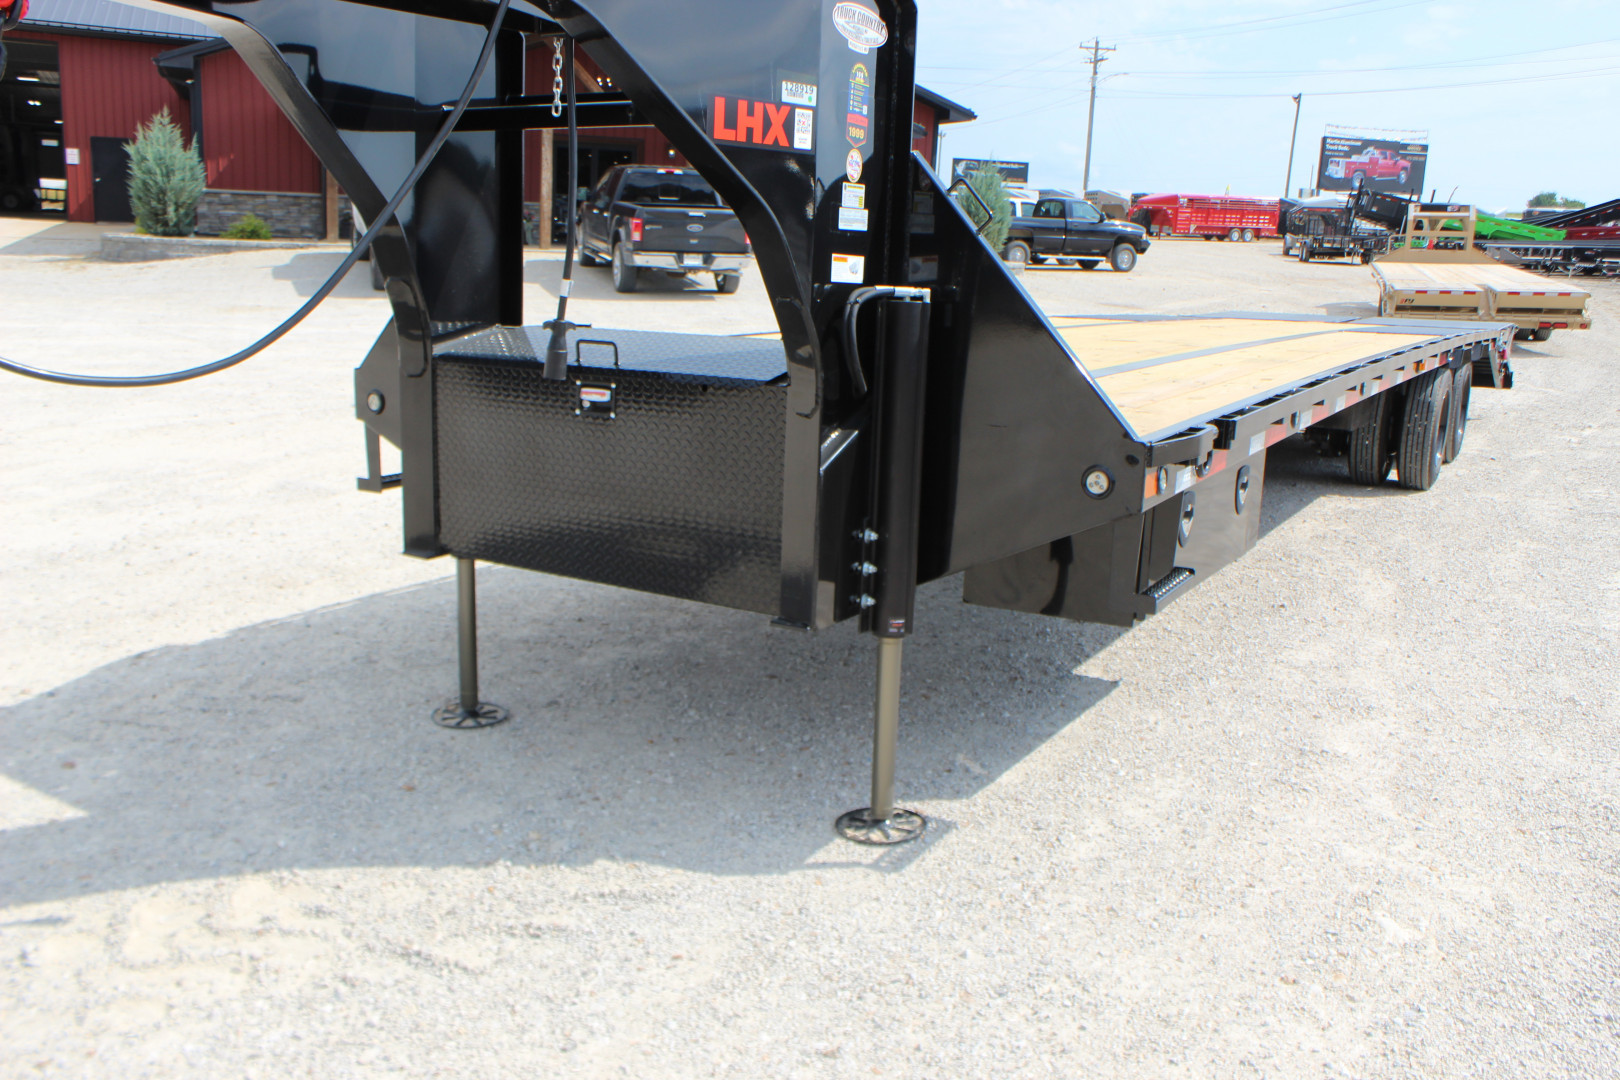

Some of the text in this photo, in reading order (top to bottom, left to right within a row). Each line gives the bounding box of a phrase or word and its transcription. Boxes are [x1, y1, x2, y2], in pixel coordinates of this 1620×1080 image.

[836, 5, 857, 21] TRUCK
[857, 11, 885, 34] COUNTRY
[784, 82, 814, 95] 128919
[713, 96, 791, 147] LHX
[848, 126, 865, 140] 1999
